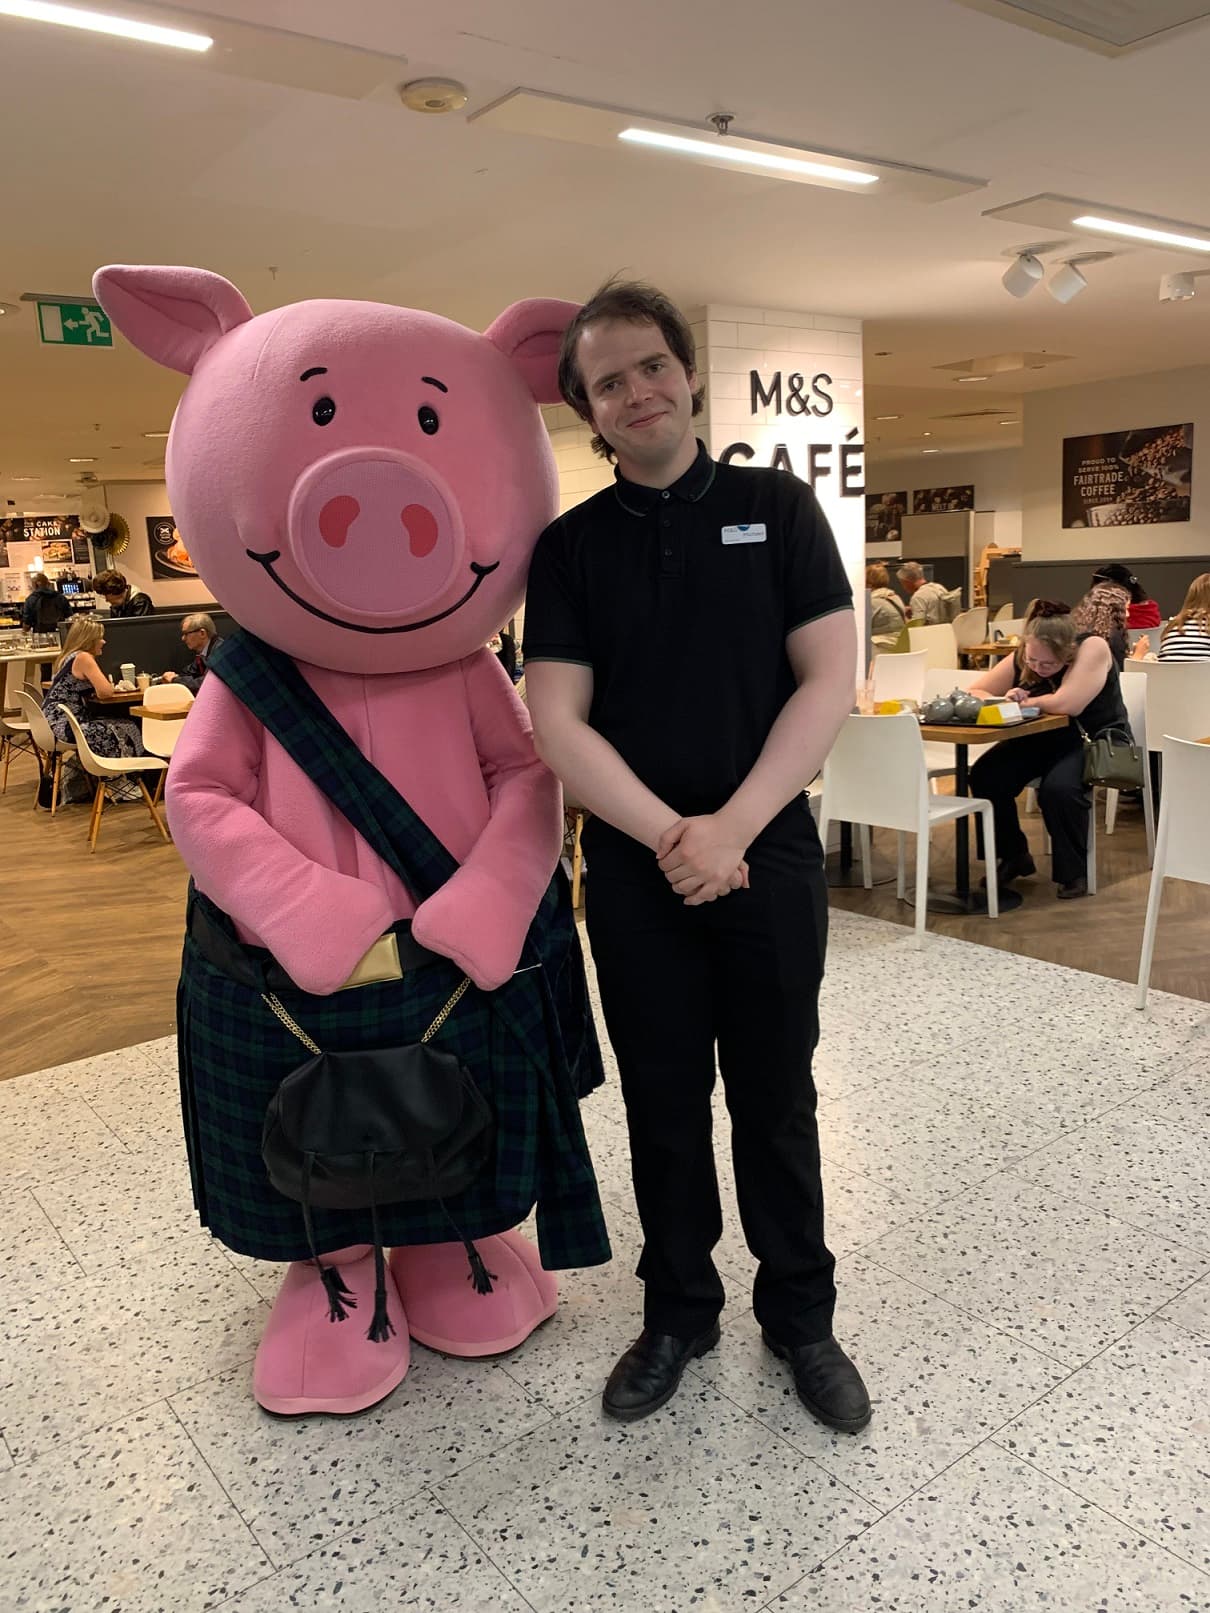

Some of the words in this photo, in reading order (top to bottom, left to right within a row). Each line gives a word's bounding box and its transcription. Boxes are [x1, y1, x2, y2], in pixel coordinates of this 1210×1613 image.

[750, 369, 833, 417] M&S
[1073, 471, 1124, 486] FAIRTRADE
[1081, 484, 1116, 497] COFFEE
[23, 527, 61, 538] STATION
